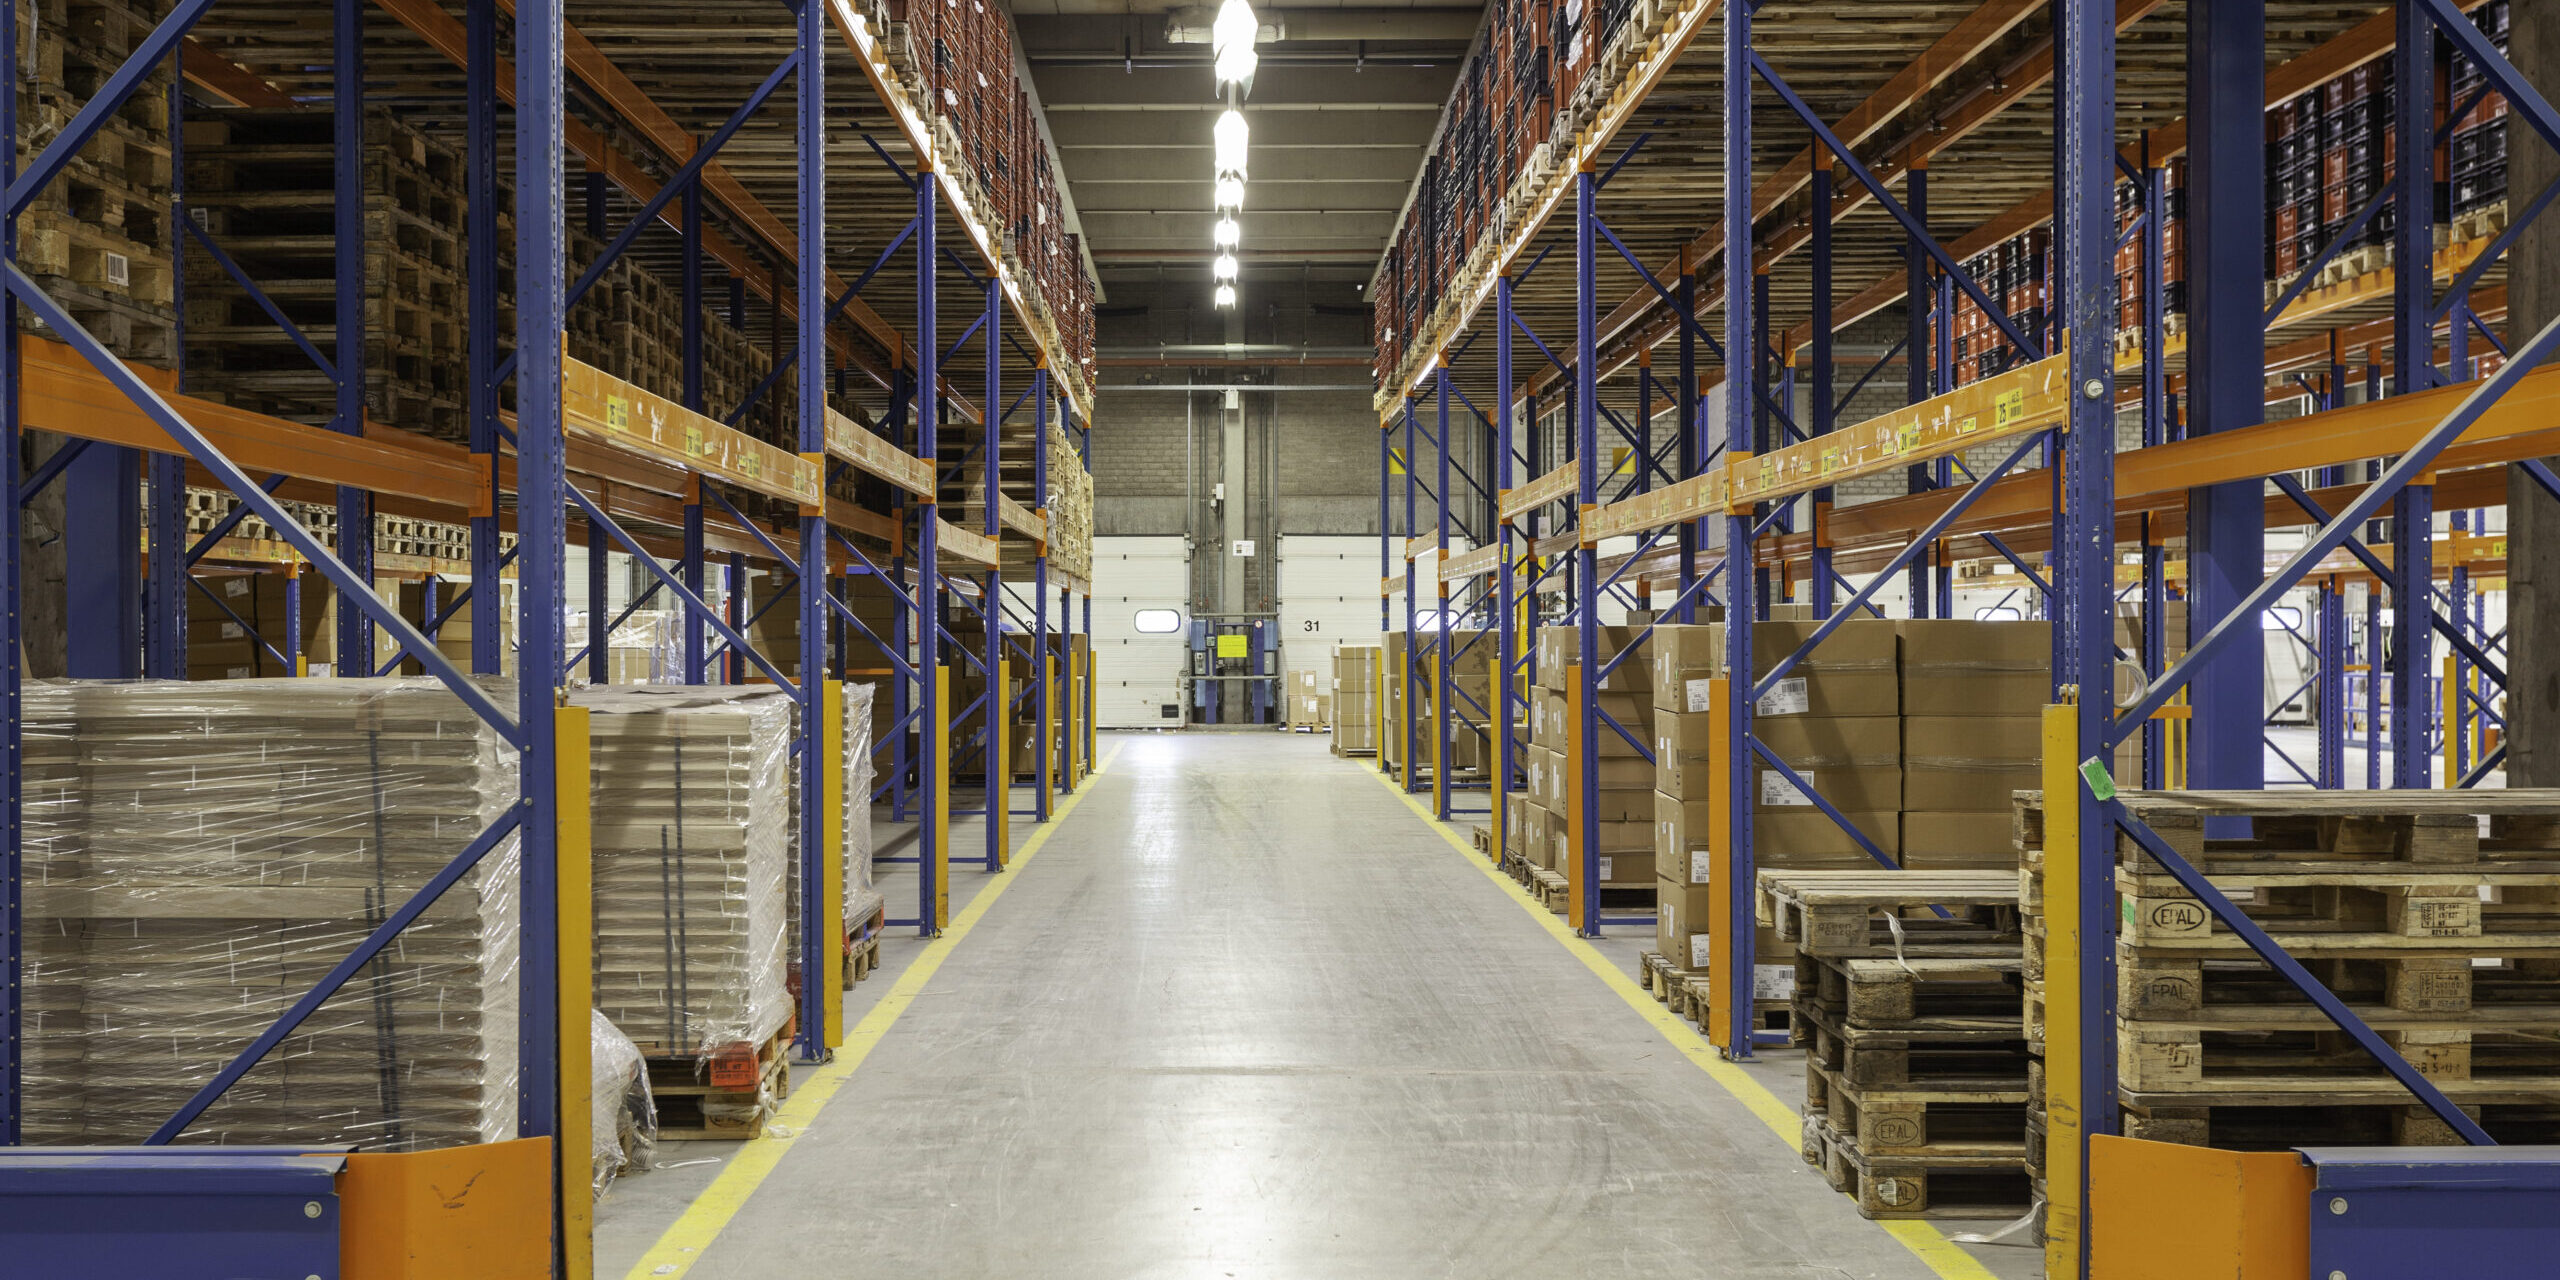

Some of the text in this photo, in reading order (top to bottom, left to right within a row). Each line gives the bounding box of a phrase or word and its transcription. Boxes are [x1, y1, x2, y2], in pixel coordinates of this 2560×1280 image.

[1304, 620, 1320, 632] 31
[2160, 908, 2197, 926] EPAL
[1880, 1124, 1911, 1139] EPAL
